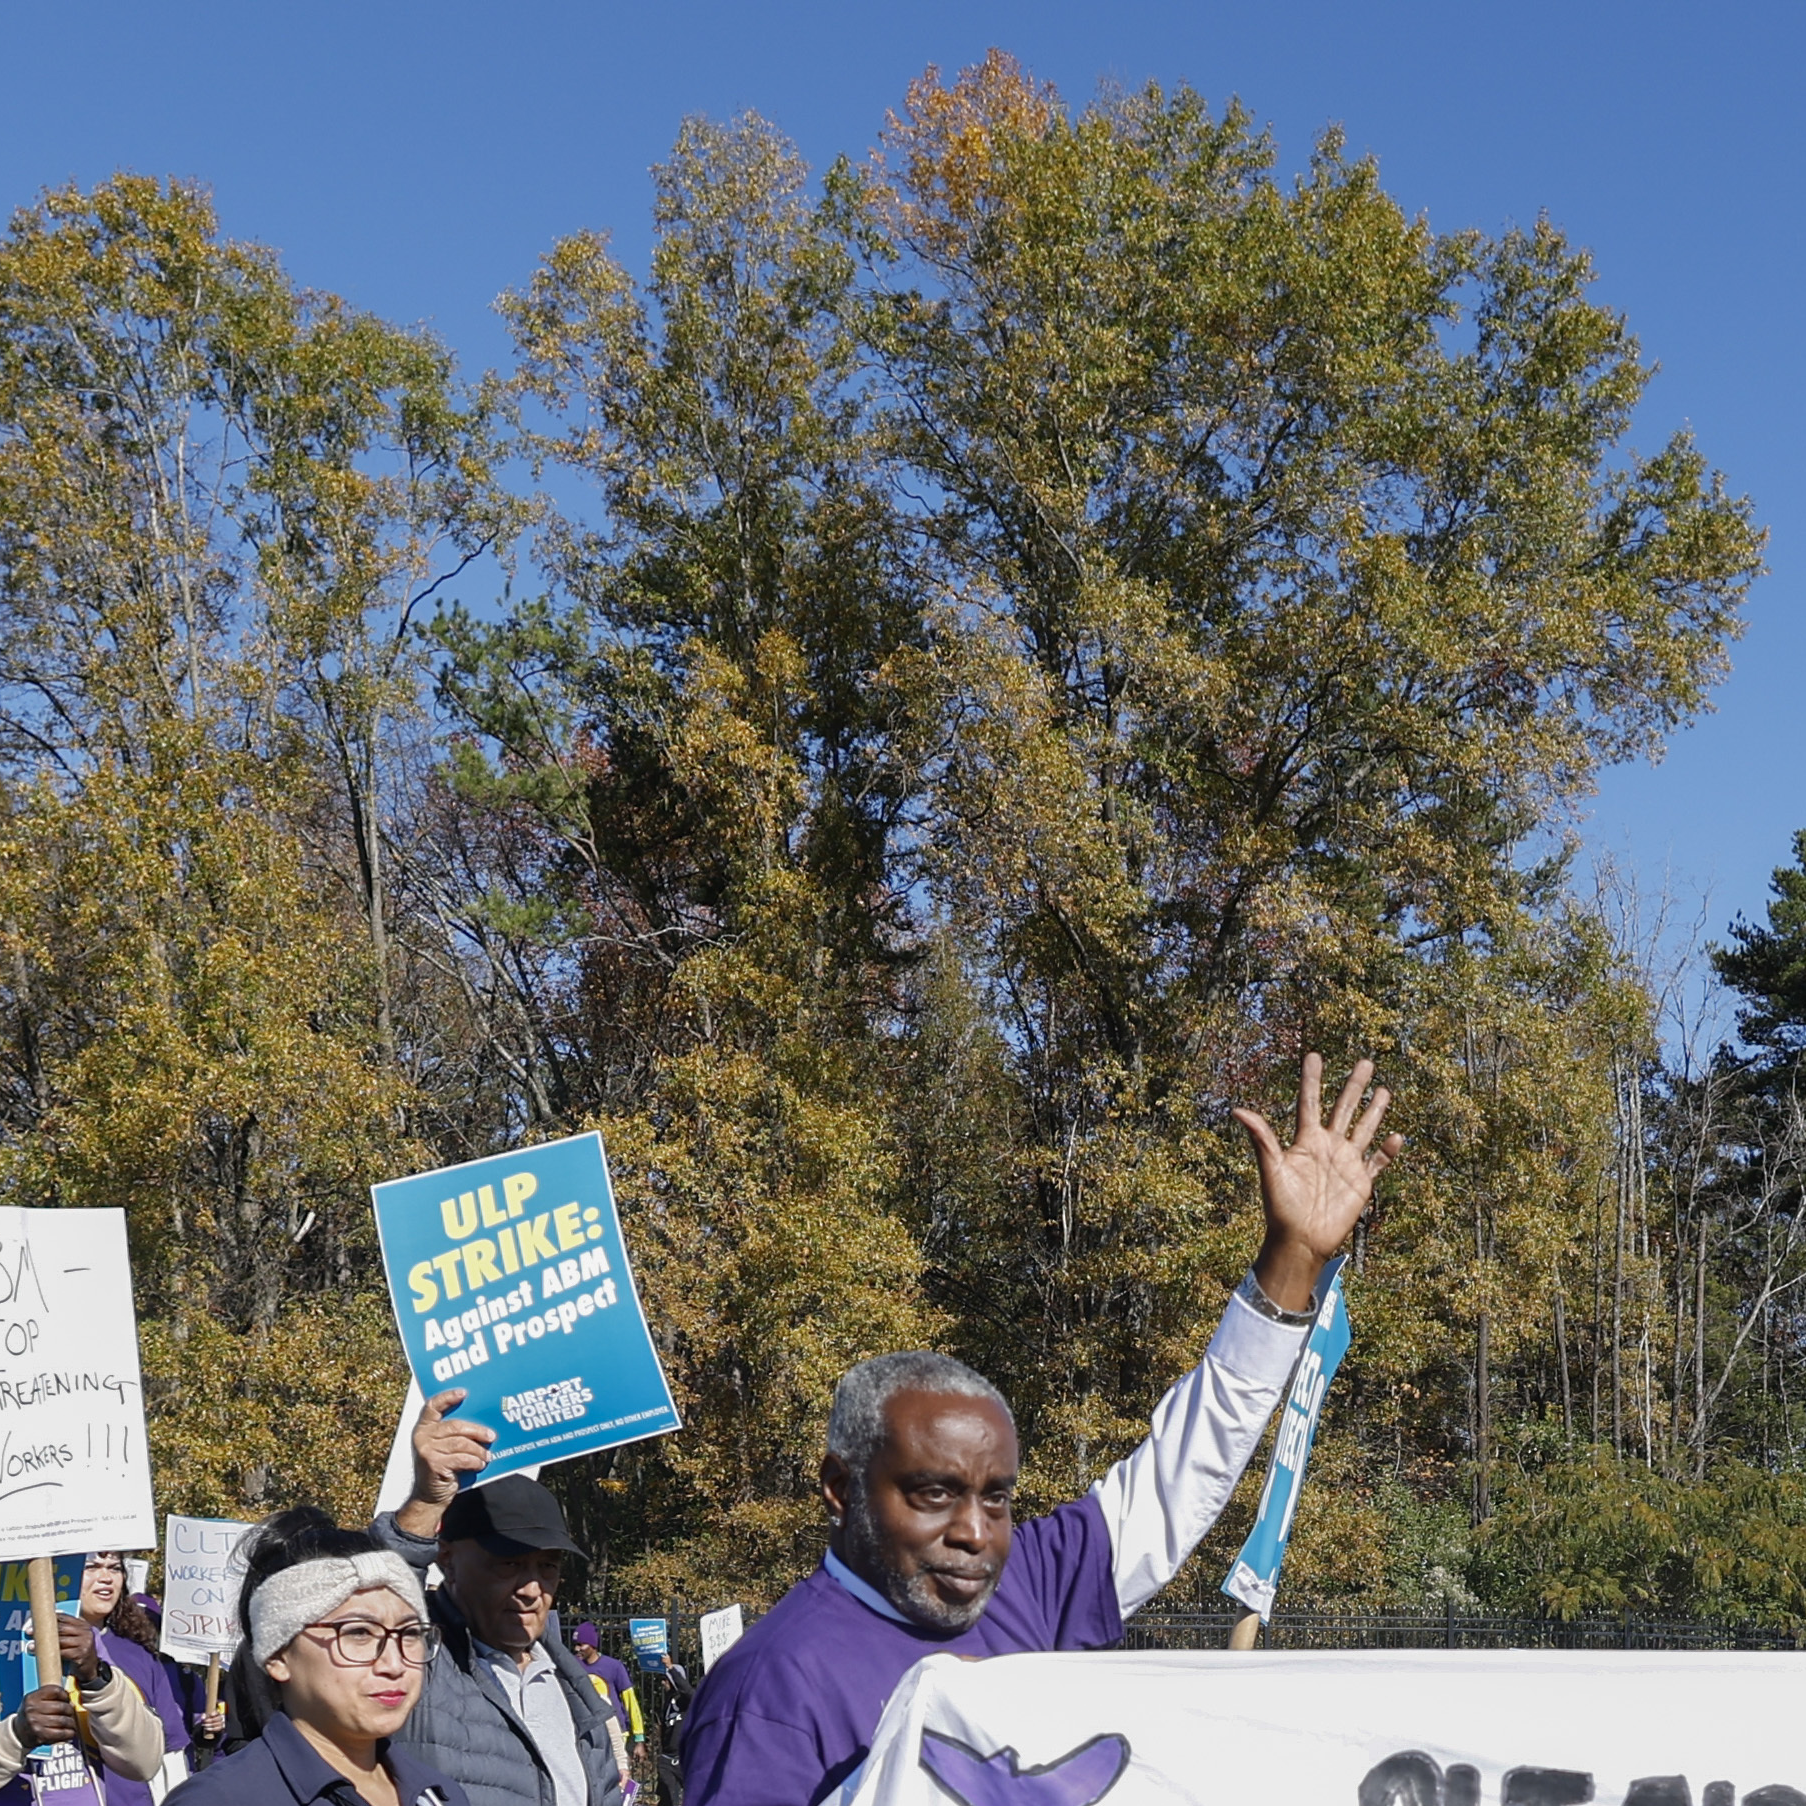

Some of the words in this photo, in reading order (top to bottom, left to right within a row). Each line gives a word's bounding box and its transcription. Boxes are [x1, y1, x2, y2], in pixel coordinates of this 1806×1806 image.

[440, 1172, 538, 1240] ULP
[408, 1201, 603, 1313] STRIKE:
[424, 1280, 533, 1351] Against
[542, 1246, 610, 1298] ABM
[433, 1332, 489, 1382] and
[493, 1277, 617, 1355] Prospect
[503, 1388, 593, 1423] WORKERS
[508, 1376, 582, 1410] AIRPORT
[519, 1405, 586, 1431] UNITED
[175, 1523, 237, 1554] CLT
[191, 1587, 224, 1606] ON
[36, 1772, 85, 1793] FLIGHT
